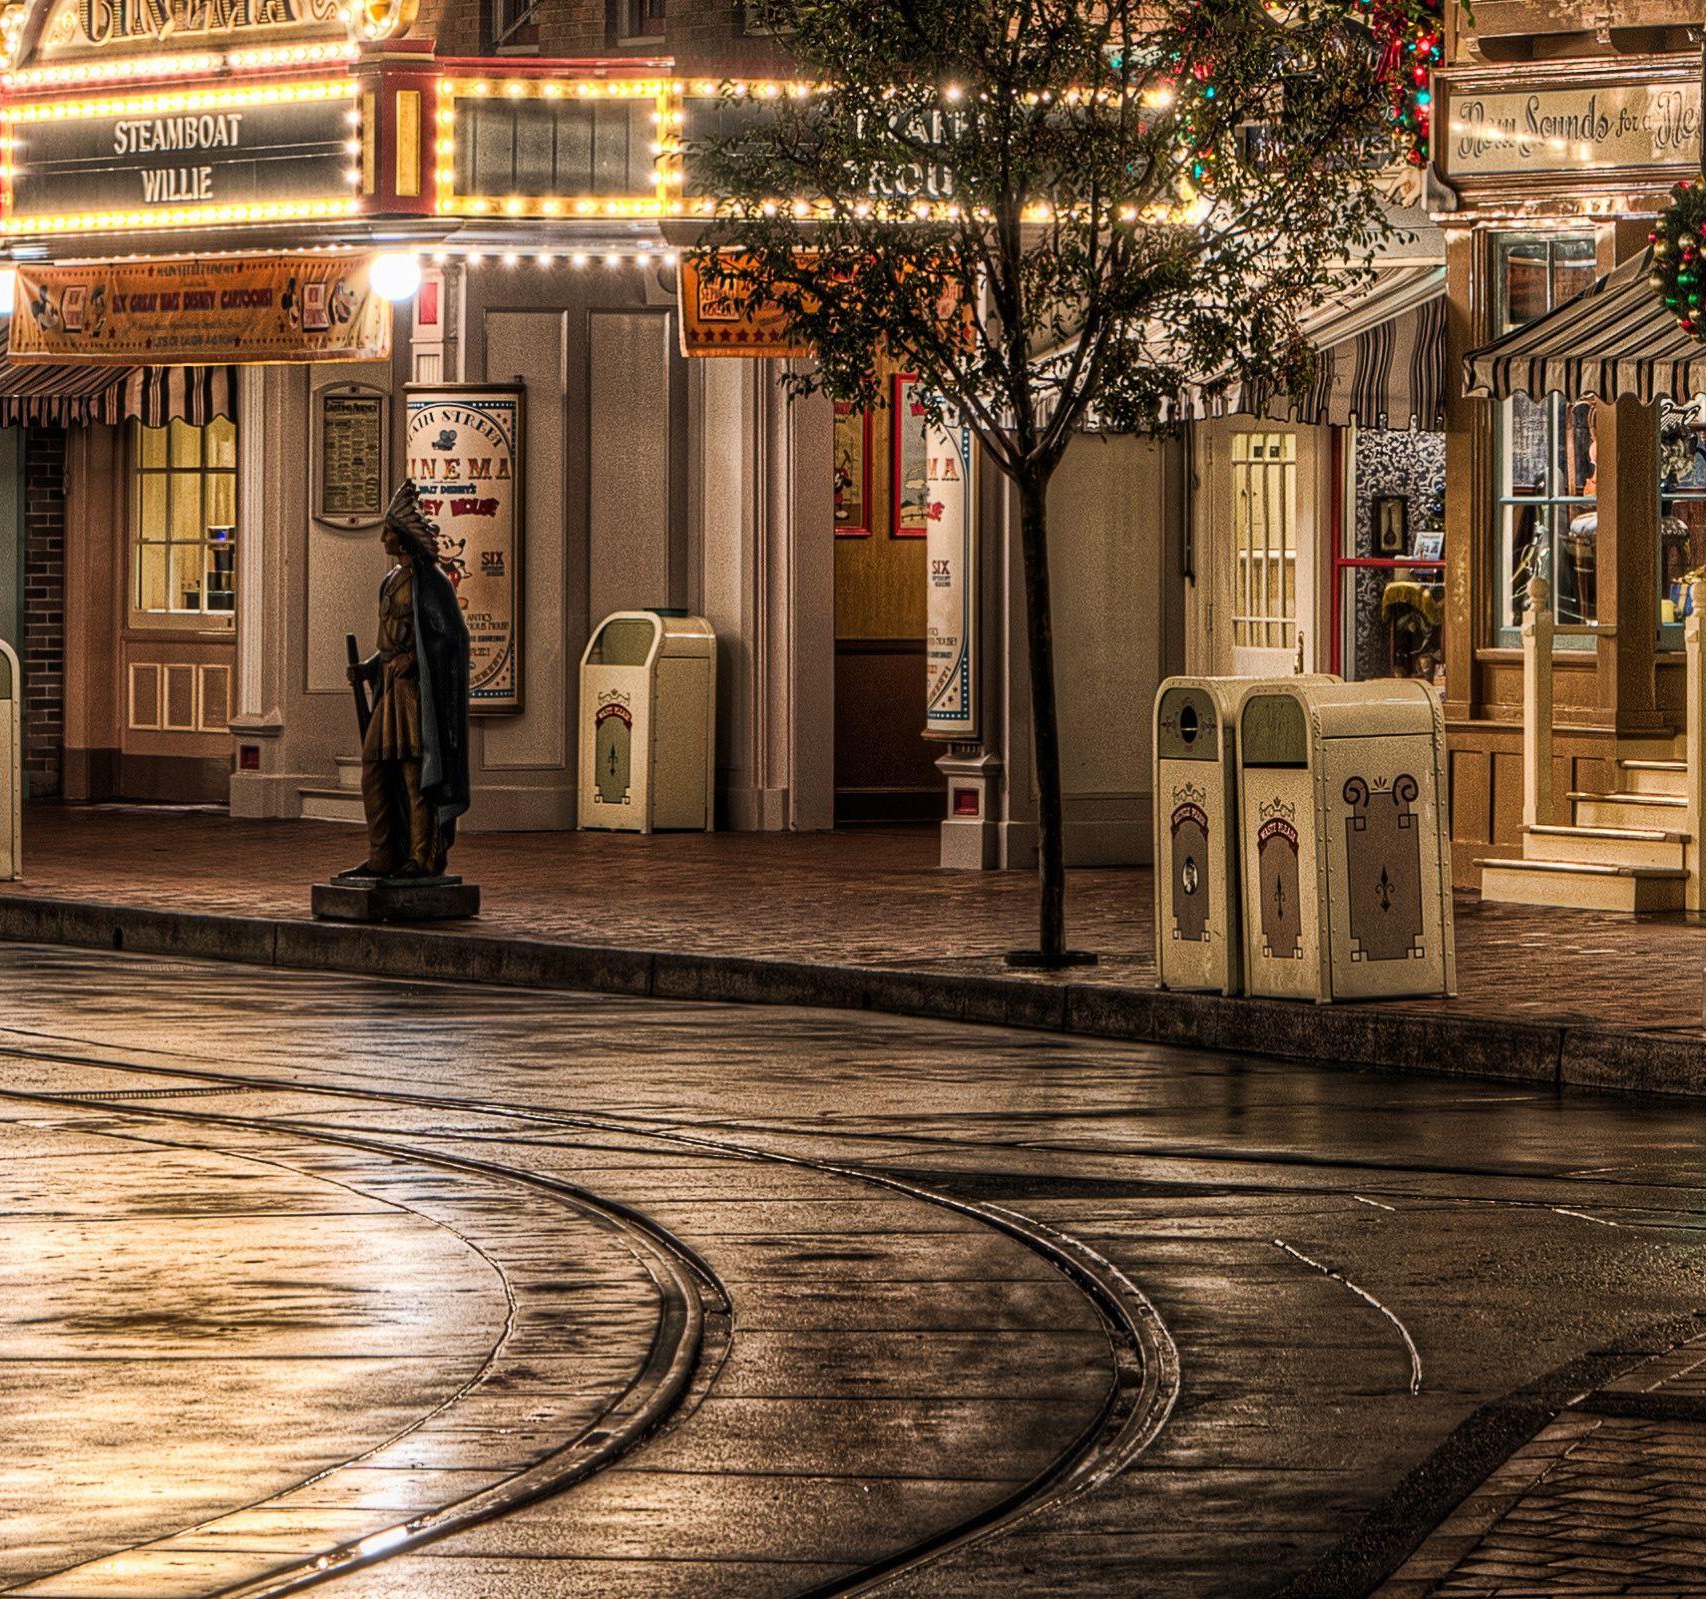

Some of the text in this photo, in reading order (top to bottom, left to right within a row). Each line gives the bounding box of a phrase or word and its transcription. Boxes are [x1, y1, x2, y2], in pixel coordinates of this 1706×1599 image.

[113, 113, 243, 155] STEAMBOAT
[1519, 94, 1613, 158] Sounds
[1617, 108, 1639, 138] for
[1643, 118, 1653, 133] a
[1654, 91, 1702, 150] Ne
[141, 166, 214, 203] WILLIE
[442, 410, 504, 448] STREET
[409, 457, 511, 481] INEMA
[481, 551, 505, 566] SIX
[932, 560, 950, 575] SIX
